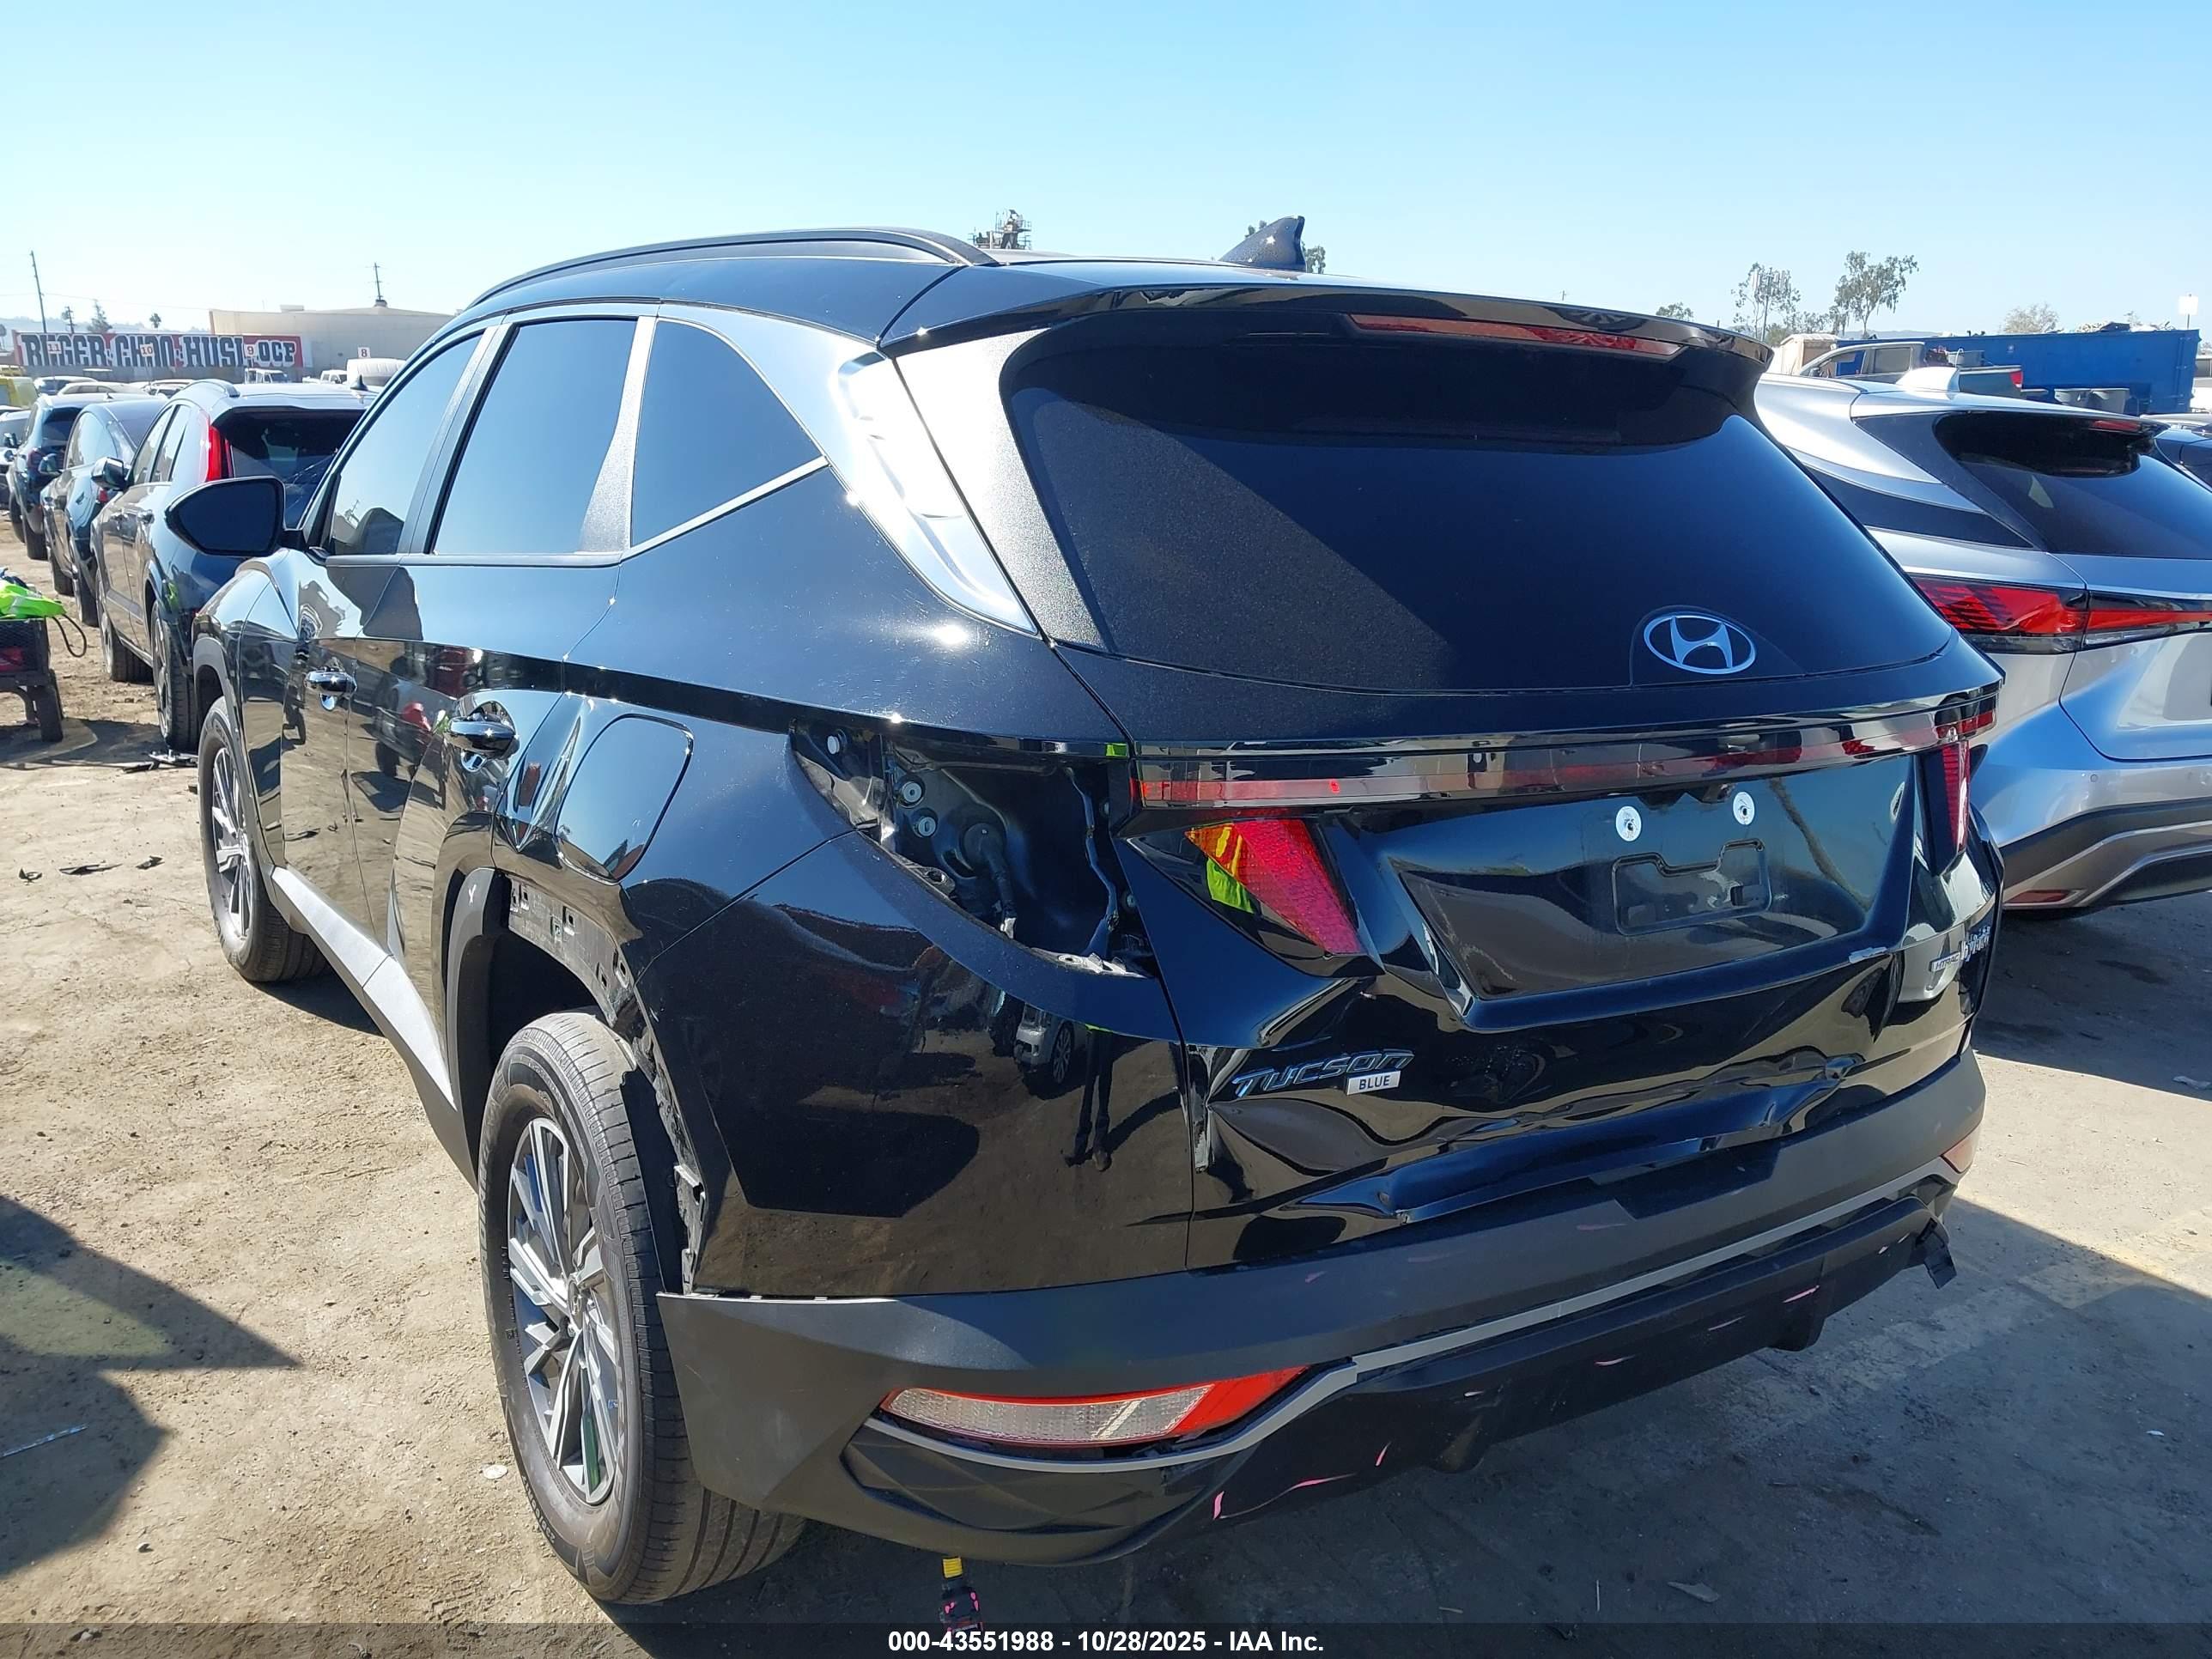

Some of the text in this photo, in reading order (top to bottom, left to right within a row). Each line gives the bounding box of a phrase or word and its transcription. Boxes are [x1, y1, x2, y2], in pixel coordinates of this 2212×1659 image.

[47, 343, 61, 352] 11
[141, 345, 153, 355] 10
[246, 345, 254, 356] 9
[361, 349, 368, 358] 8
[1231, 1048, 1415, 1098] TUCSON
[1358, 1074, 1391, 1091] BLUE
